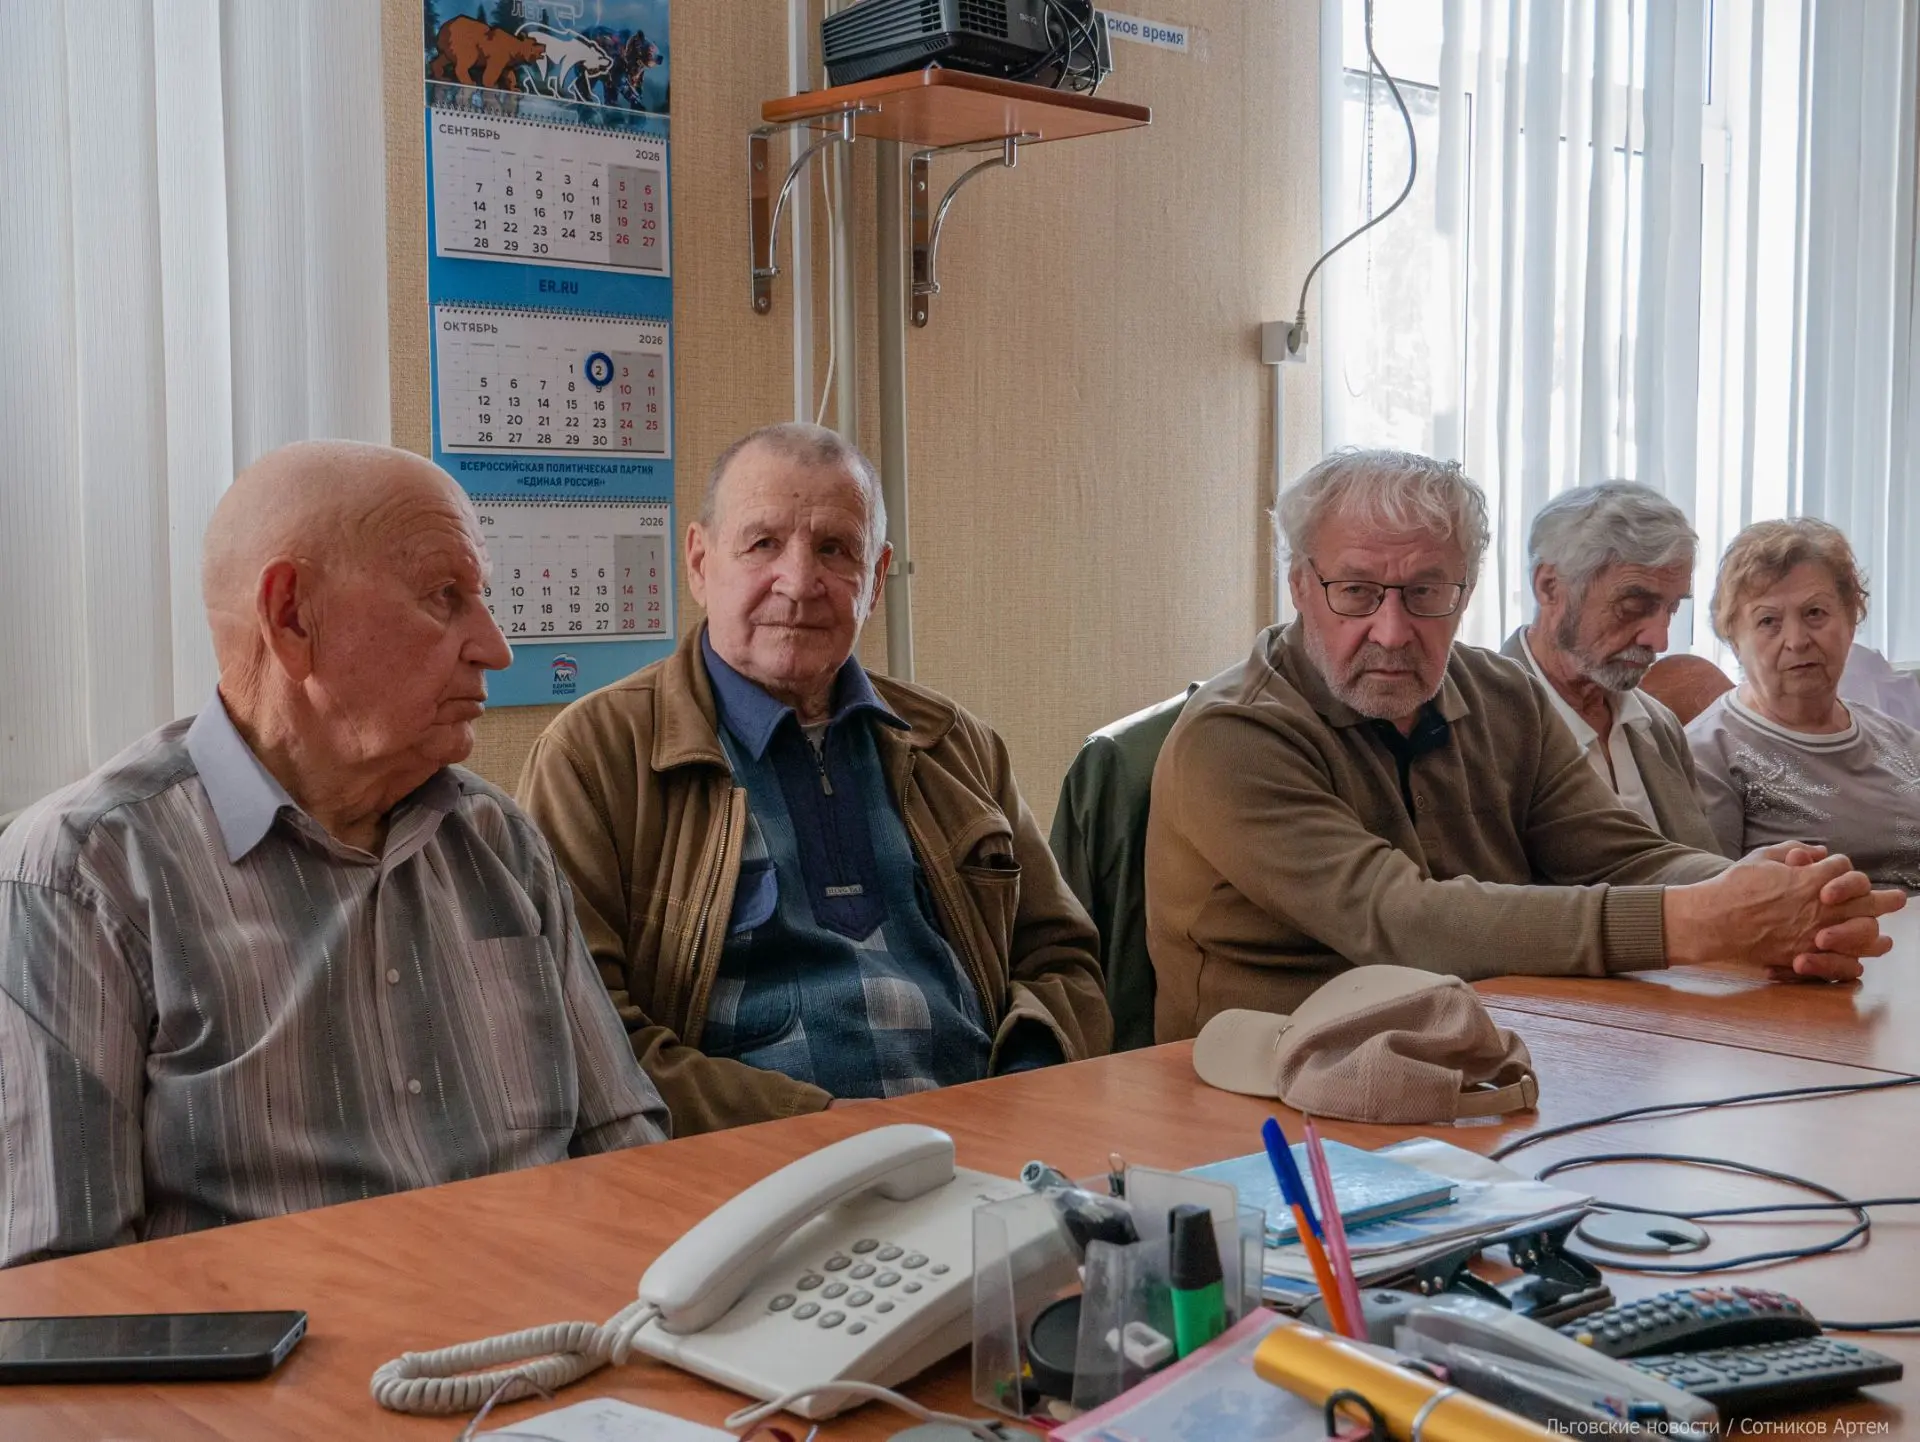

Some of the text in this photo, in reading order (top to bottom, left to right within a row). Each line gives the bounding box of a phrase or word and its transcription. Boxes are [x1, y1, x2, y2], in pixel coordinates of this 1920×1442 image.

[1142, 25, 1184, 45] время
[439, 124, 500, 140] СЕНТЯБРЬ
[507, 168, 651, 195] 1 2 3 4 5 6
[476, 183, 654, 212] 7 8 9 10 11 12 13
[473, 201, 656, 230] 14 15 16 17 18 19 20
[474, 220, 655, 247] 21 22 23 24 25 26 27
[474, 238, 549, 254] 28 29 30
[539, 279, 578, 295] ER.RU
[443, 321, 498, 334] ОКТЯБРЬ
[569, 365, 655, 378] 1 2 3 4
[480, 377, 487, 388] 5
[510, 379, 518, 389] 6
[540, 380, 547, 390] 7
[568, 382, 575, 391] 8
[619, 385, 632, 395] 10
[648, 387, 655, 396] 11
[478, 396, 657, 413] 12 13 14 15 16 17 18
[479, 414, 658, 430] 19 20 21 22 23 24 25
[478, 432, 632, 446] 26 27 28 29 30 31
[460, 461, 653, 475] ВСЕРОССИЙСКАЯ ПОЛИТИЧЕСКАЯ ПАРТИЯ
[651, 551, 654, 559] 1
[514, 568, 656, 579] 3 4 5 6 7 8
[484, 585, 658, 597] 9 10 11 12 13 14 15
[513, 605, 524, 614] 17
[541, 604, 552, 613] 18
[569, 604, 580, 613] 19
[595, 603, 609, 612] 20
[623, 602, 633, 612] 21
[647, 602, 659, 611] 22
[511, 623, 526, 632] 24
[541, 622, 554, 631] 25
[568, 621, 582, 631] 26
[596, 621, 609, 629] 27
[622, 620, 635, 629] 28
[647, 619, 660, 628] 29
